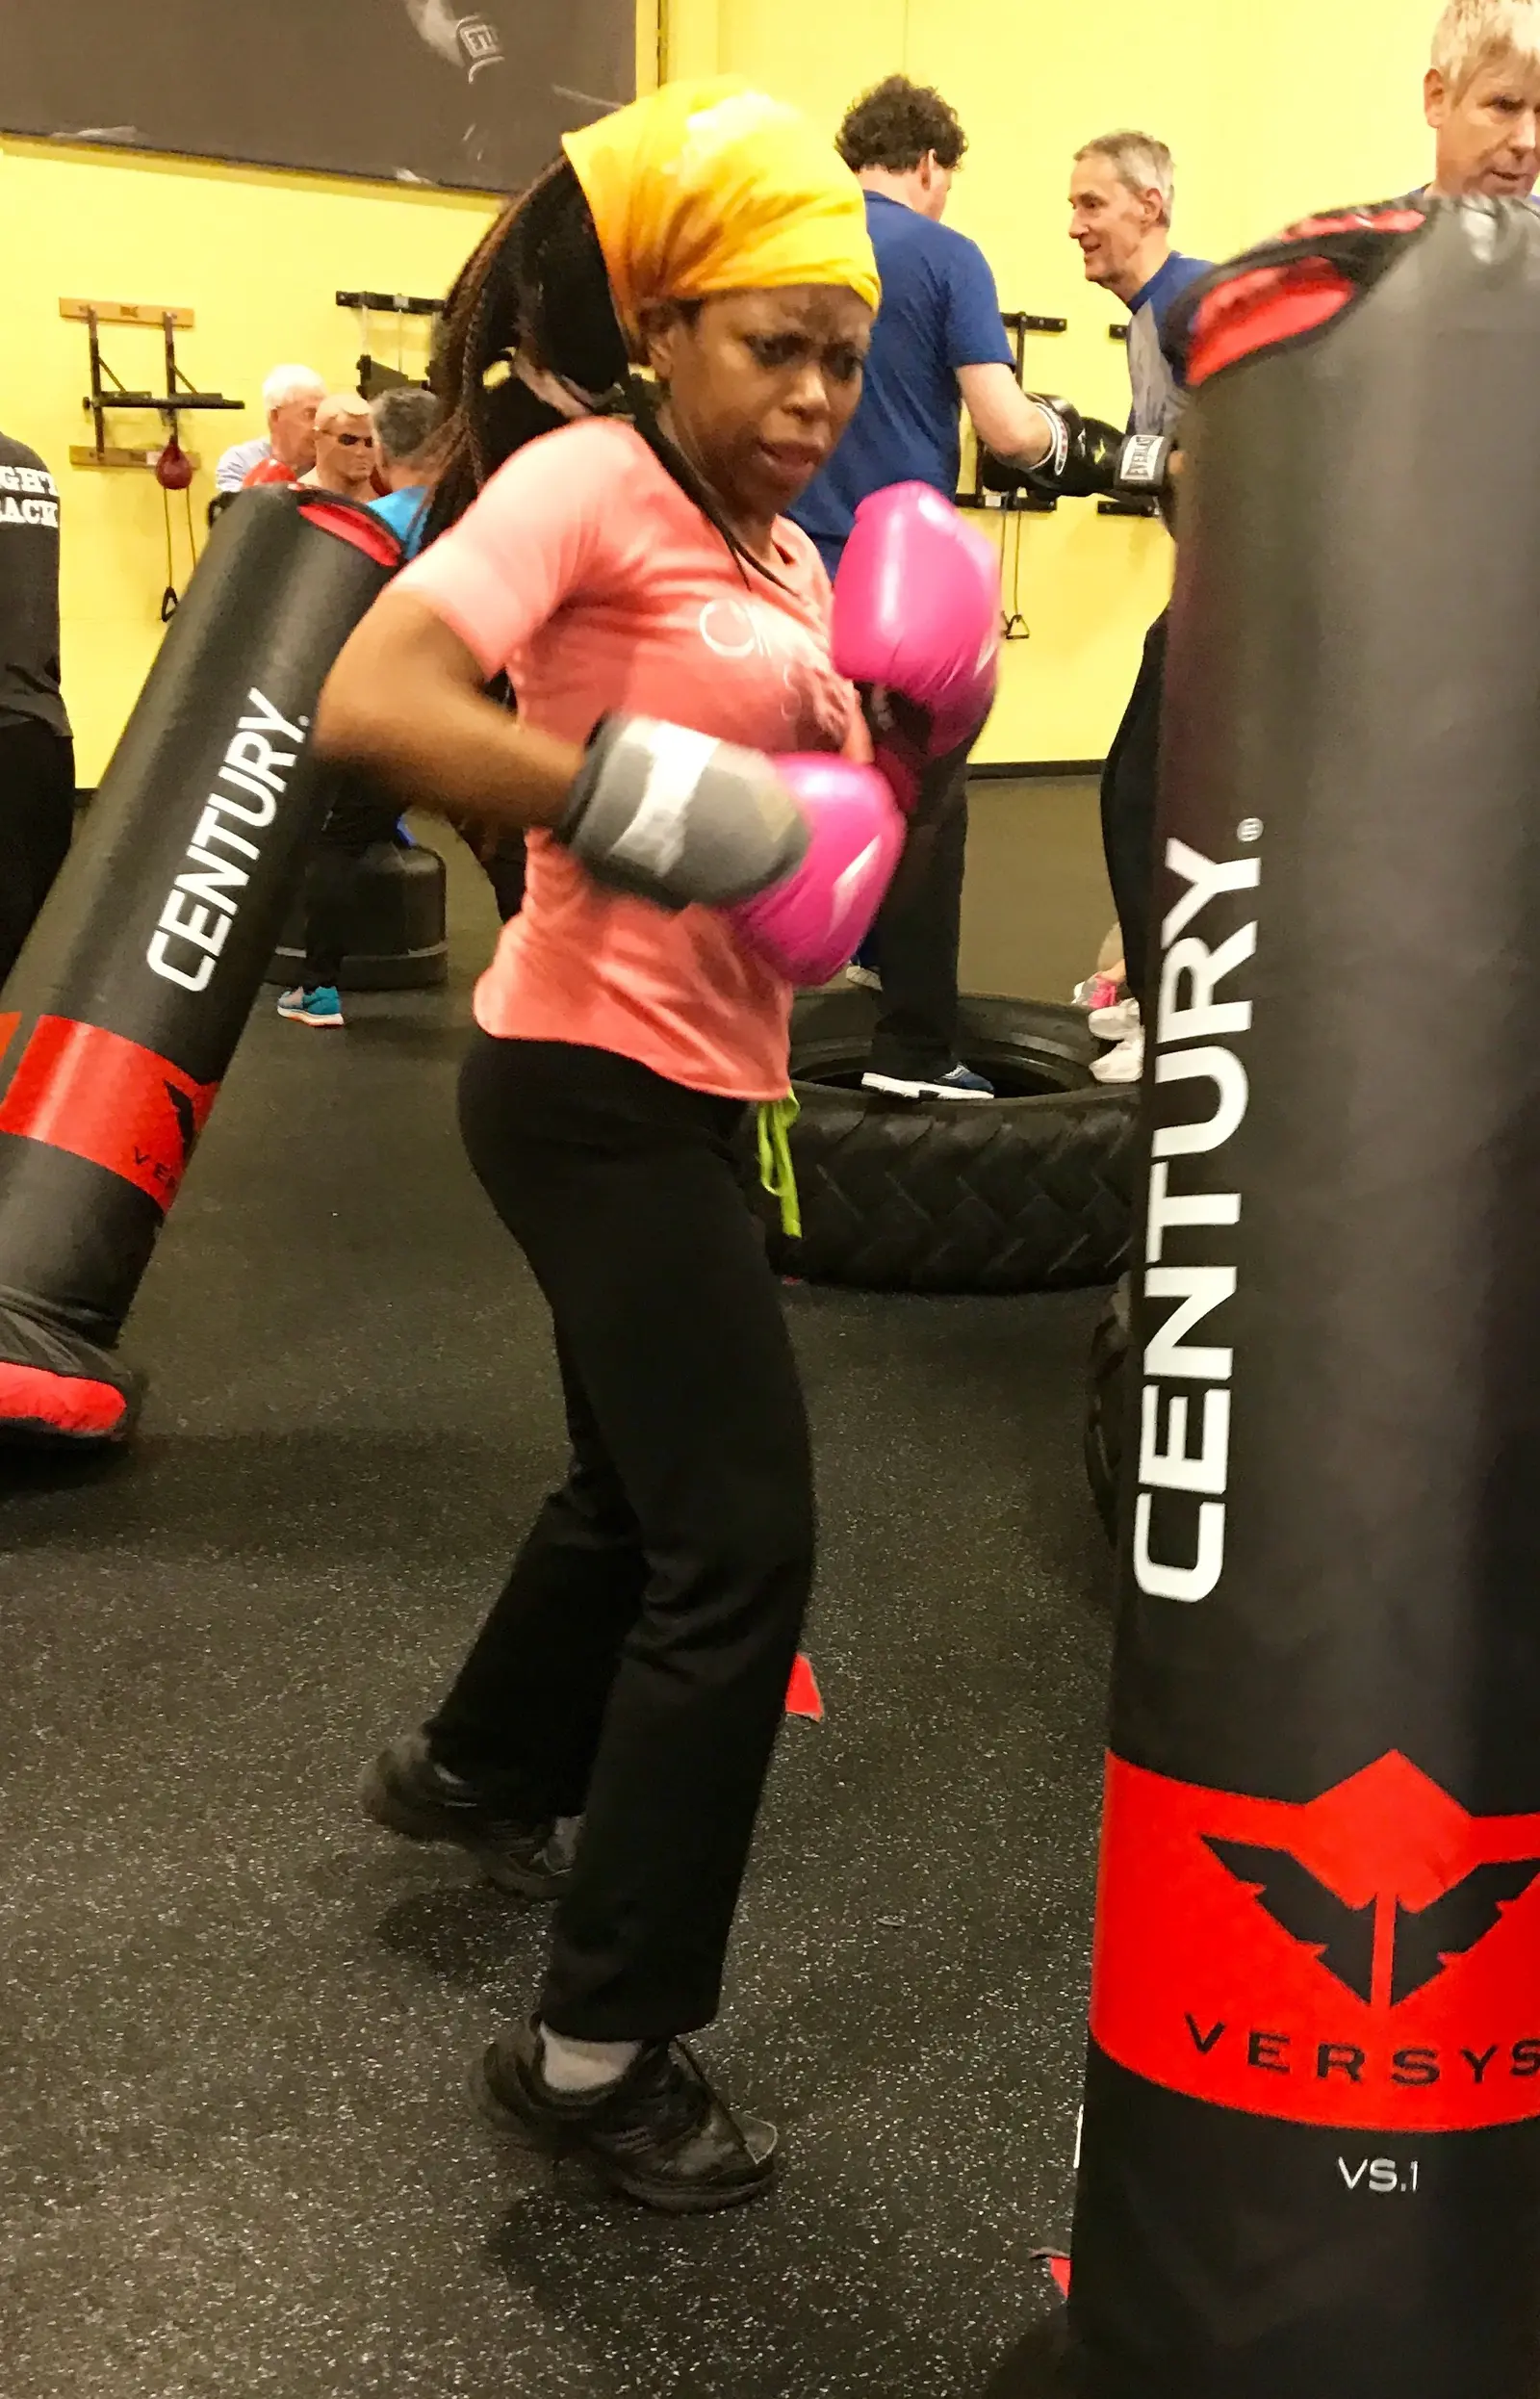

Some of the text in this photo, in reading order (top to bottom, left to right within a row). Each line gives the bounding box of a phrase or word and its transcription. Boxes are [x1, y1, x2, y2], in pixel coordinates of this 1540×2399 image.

[0, 496, 59, 528] ACK
[146, 687, 306, 992] CENTURY
[1134, 837, 1262, 1604] CENTURY
[1185, 2013, 1540, 2087] VERSYS
[1337, 2156, 1419, 2192] VS.1
